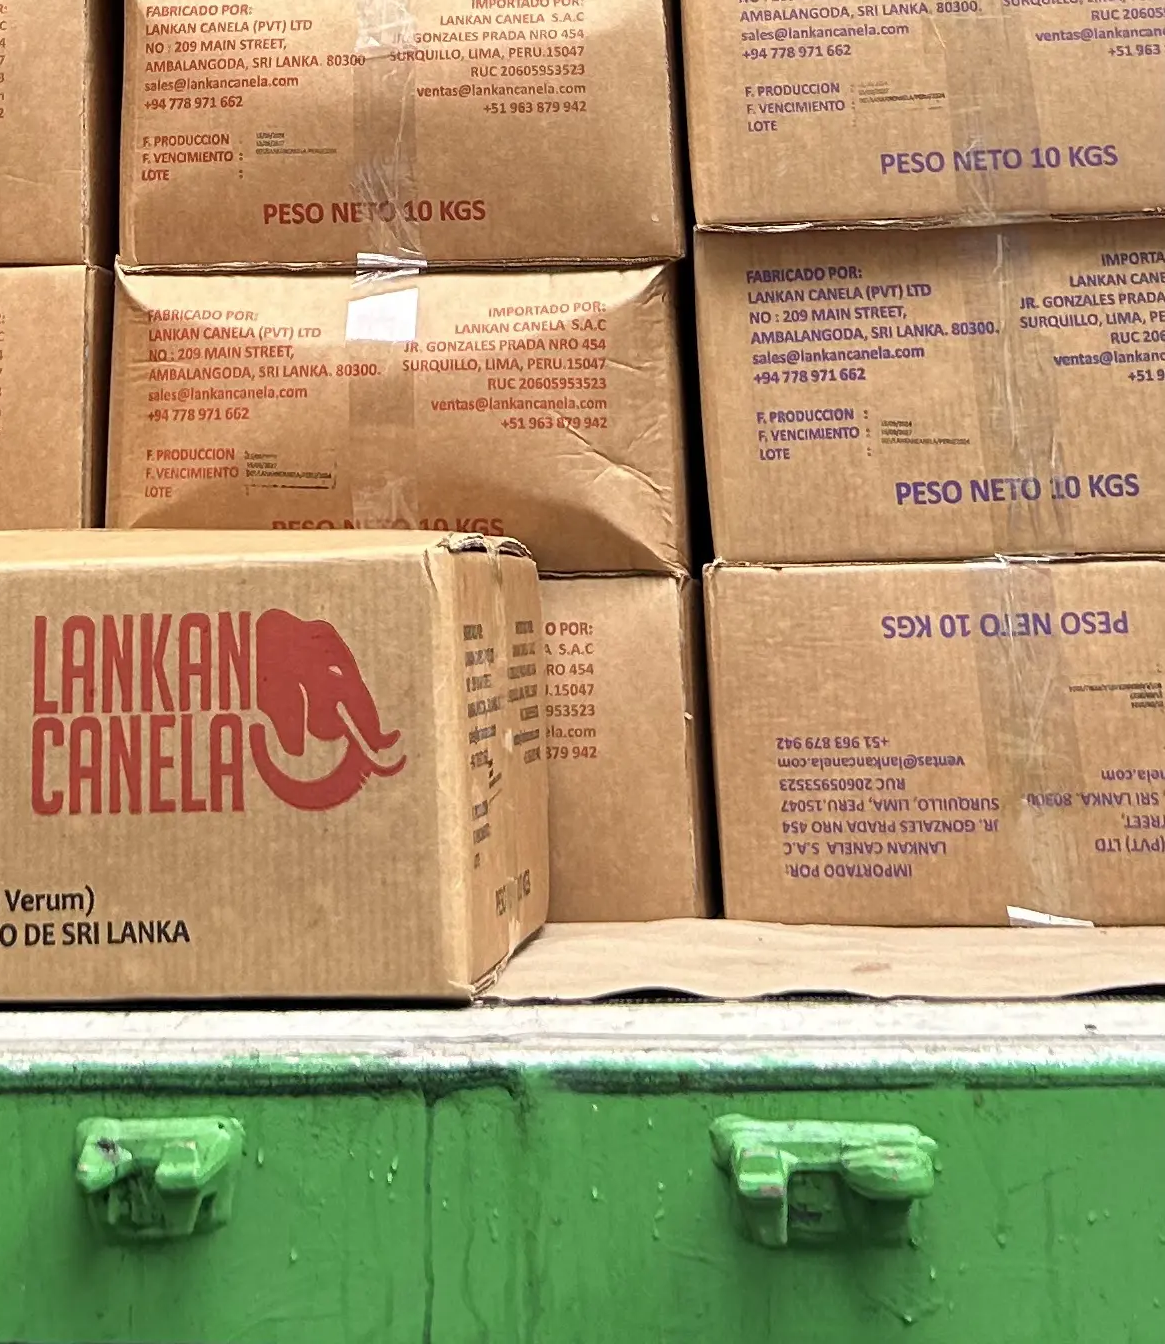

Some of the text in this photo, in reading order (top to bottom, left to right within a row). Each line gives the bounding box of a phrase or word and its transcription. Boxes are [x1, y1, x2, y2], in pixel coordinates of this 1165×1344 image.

[857, 4, 879, 18] SRI
[741, 22, 910, 43] sales@lankancanela.com
[741, 43, 852, 61] +94 778 971 662
[756, 81, 841, 98] PRODUCCION
[757, 99, 846, 115] VENCIMIENTO
[747, 119, 778, 133] LOTE
[880, 144, 1119, 175] PESO NETO 10 KGS
[263, 202, 325, 226] PESO
[400, 199, 433, 223] 10
[439, 198, 486, 222] KGS
[488, 300, 607, 318] IMPORTADO POR:
[454, 322, 511, 336] LANKAN
[512, 319, 566, 333] CANELA
[425, 338, 498, 354] GONZALES
[499, 338, 546, 352] PRADA
[548, 337, 579, 351] NRO
[581, 338, 607, 352] 454
[402, 356, 607, 375] SURQUILLO, LIMA, PERU.15047
[487, 377, 607, 391] RUC 20605953523
[430, 395, 608, 413] ventas@lankancanela.com
[500, 416, 526, 430] +51
[528, 415, 554, 430] 963
[583, 415, 608, 431] 942
[881, 613, 932, 640] KGS
[939, 612, 972, 640] 10
[1060, 610, 1129, 636] PESO
[34, 612, 252, 716] LANKAN
[32, 712, 246, 816] CANELA
[4, 884, 95, 919] Verum)
[24, 922, 56, 948] DE
[61, 920, 100, 946] SRI
[107, 919, 191, 946] LANKA
